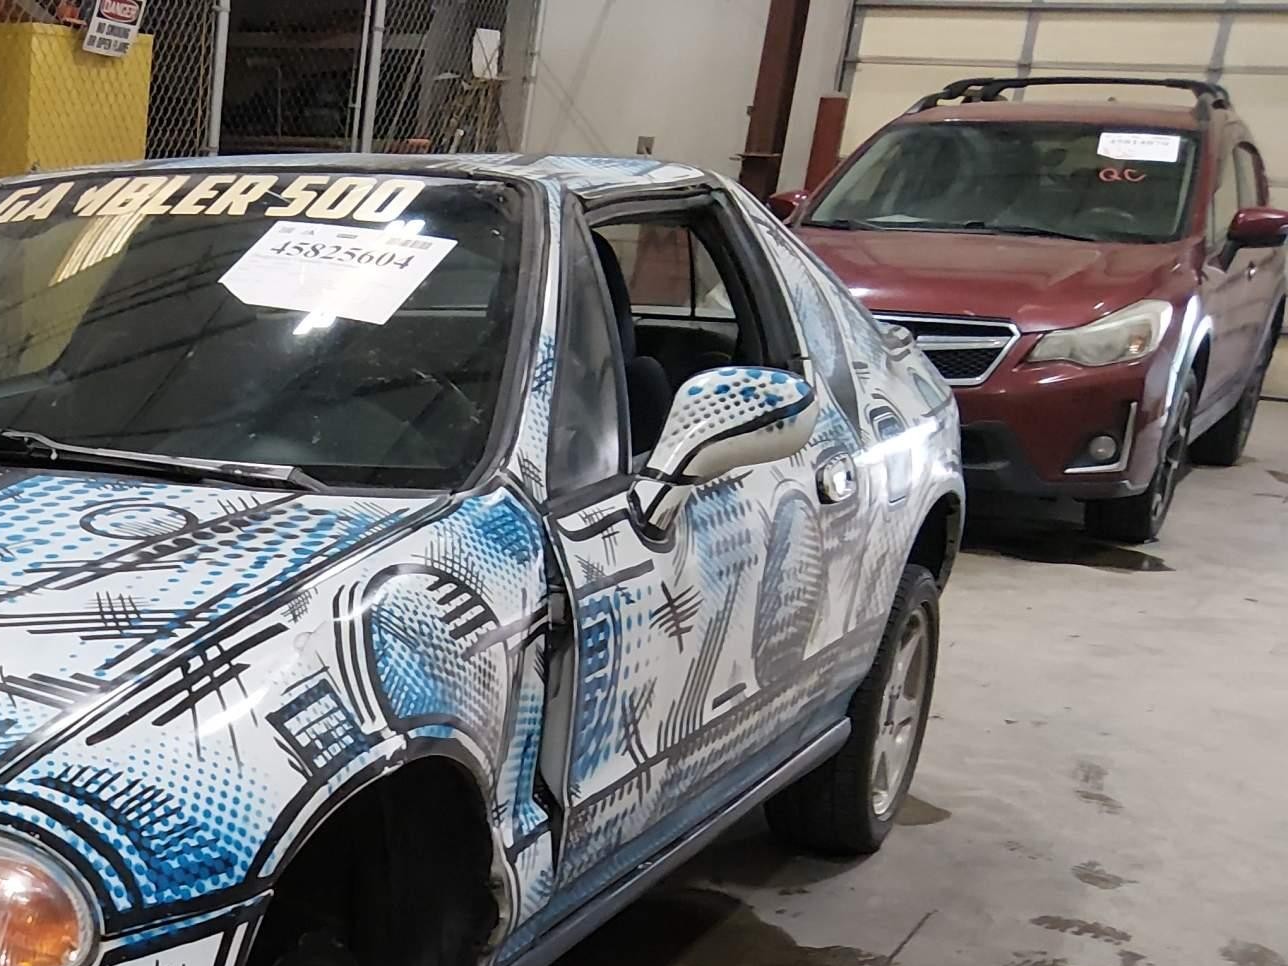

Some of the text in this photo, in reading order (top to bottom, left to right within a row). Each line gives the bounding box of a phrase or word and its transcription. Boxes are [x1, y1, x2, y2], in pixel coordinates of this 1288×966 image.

[1099, 168, 1146, 182] QC
[264, 175, 424, 223] 500
[270, 240, 416, 270] 45825604
